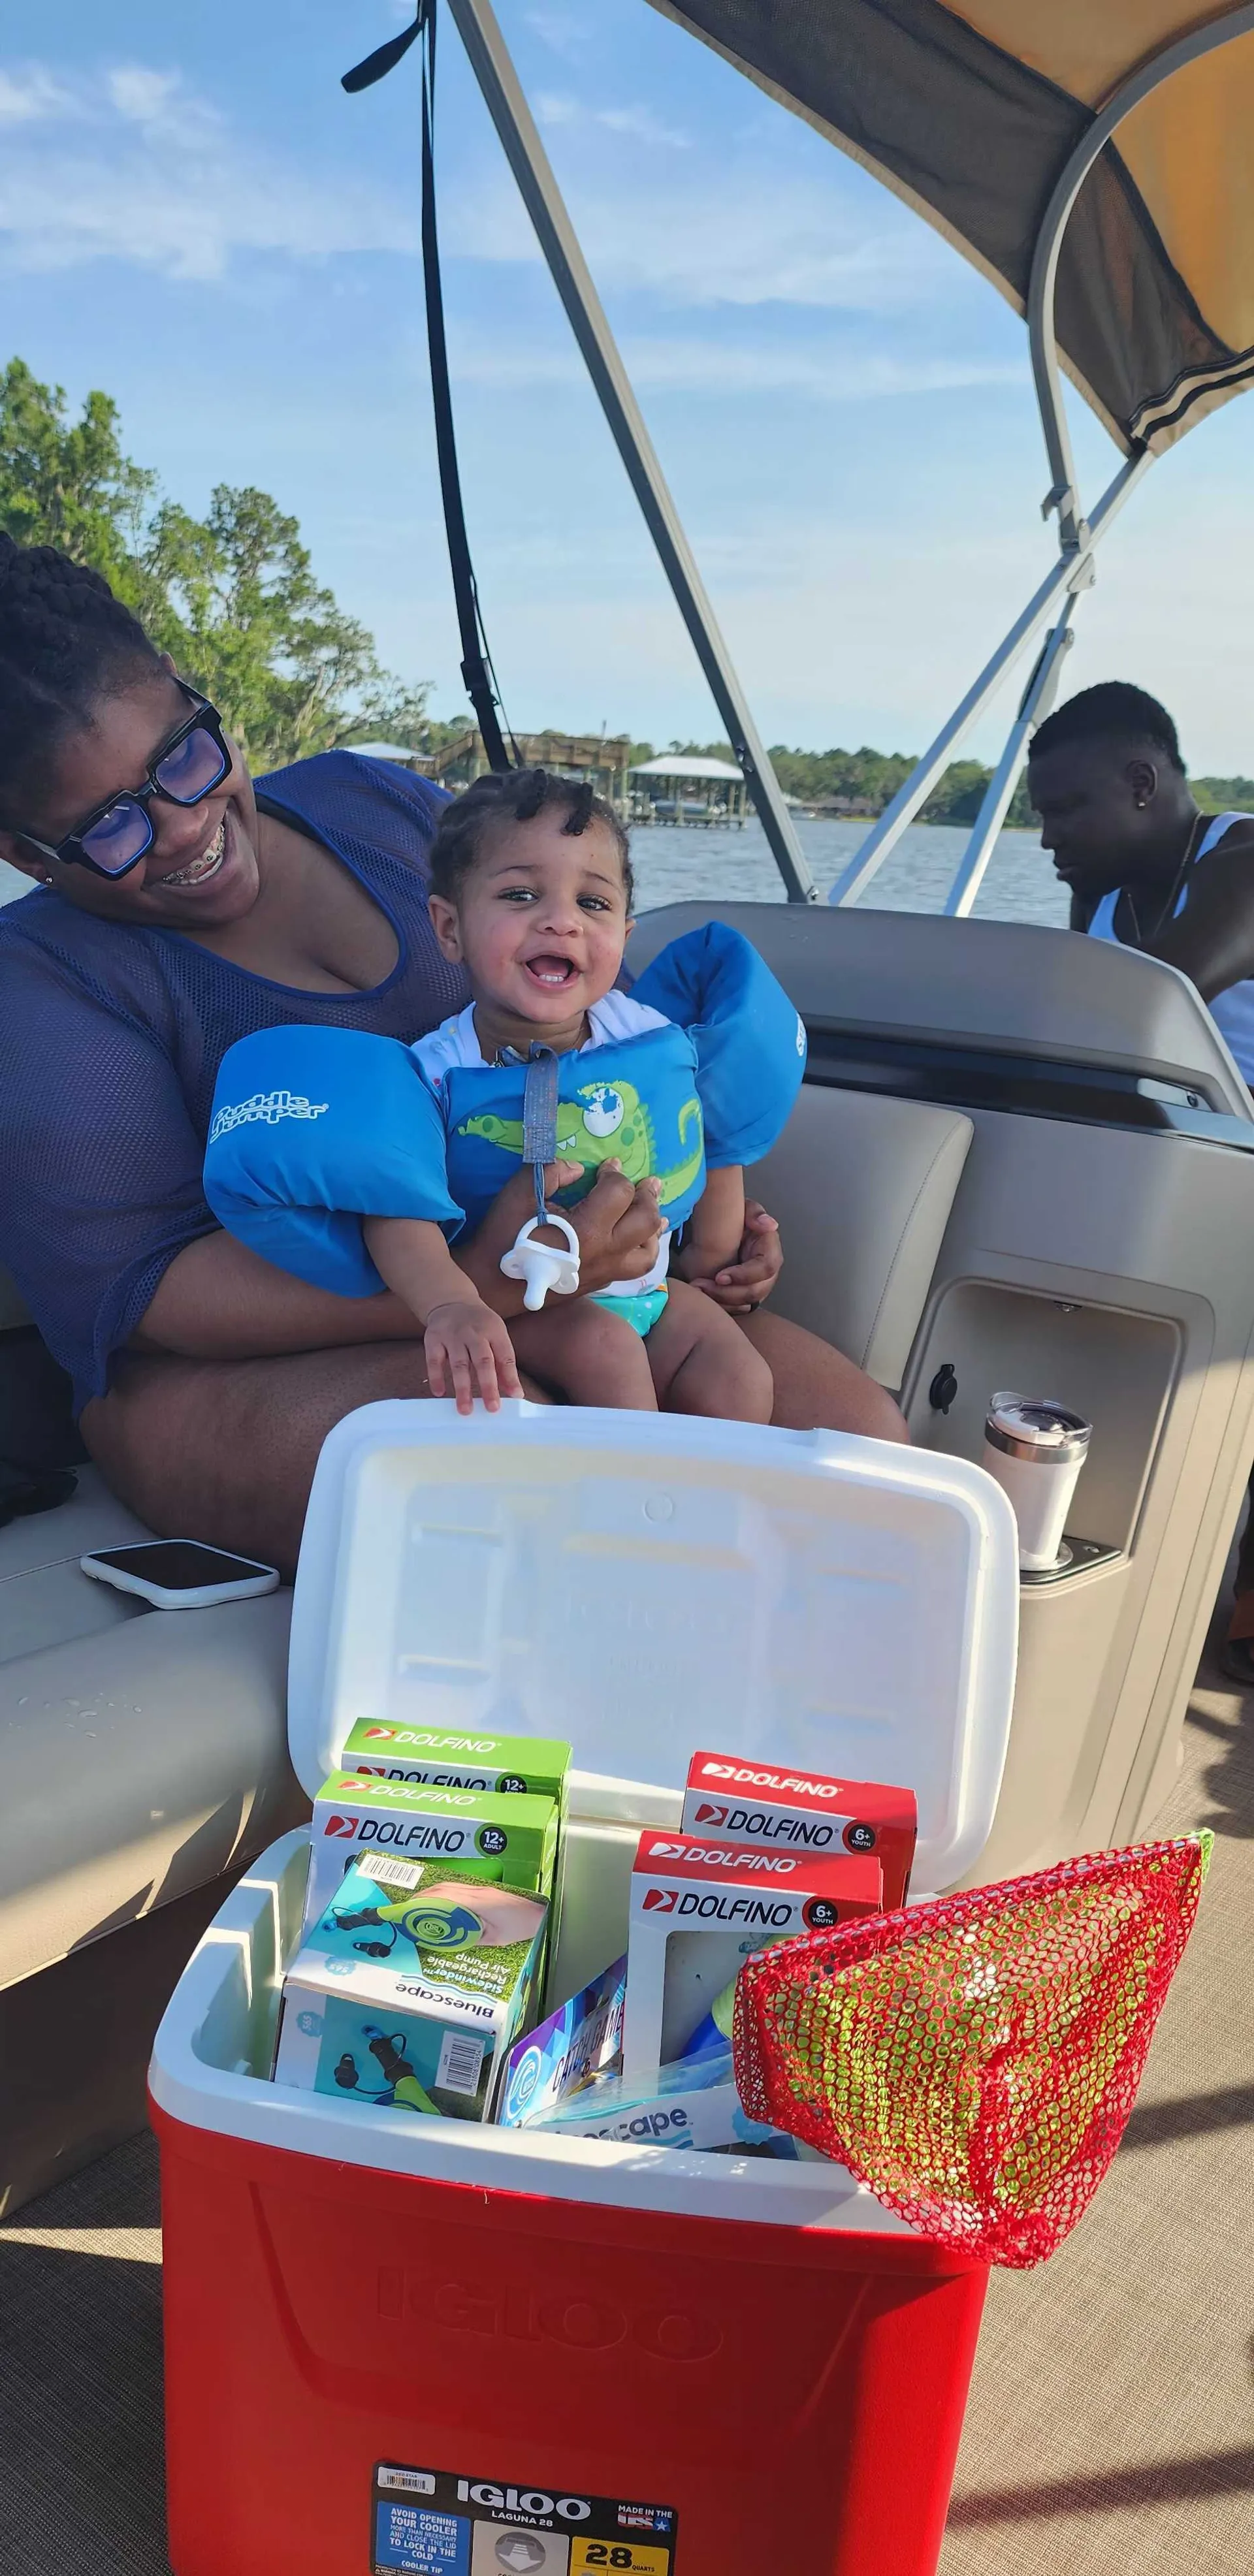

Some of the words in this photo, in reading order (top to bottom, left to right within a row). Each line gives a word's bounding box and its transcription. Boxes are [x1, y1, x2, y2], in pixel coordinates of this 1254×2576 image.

[394, 1731, 496, 1753] DOLFINO
[505, 1779, 524, 1791] 12+
[733, 1768, 839, 1798] DOLFINO
[370, 1785, 478, 1806] DOLFINO
[357, 1819, 466, 1852] DOLFINO
[726, 1809, 834, 1847] DOLFINO
[854, 1828, 871, 1841] 6+
[485, 1831, 504, 1845] 12+
[851, 1838, 871, 1848] YOUTH
[683, 1847, 797, 1873] DOLFINO
[677, 1893, 793, 1927] DOLFINO
[816, 1905, 832, 1918] 6+
[811, 1916, 834, 1925] YOUTH
[426, 1956, 507, 1985] Rechargeable
[455, 1954, 490, 1969] Pump
[491, 1965, 511, 1975] Air
[395, 1983, 495, 2018] Bluescape
[457, 2479, 591, 2520] IGLOO
[391, 2507, 417, 2519] AVOID
[419, 2513, 457, 2528] OPENING
[491, 2510, 537, 2524] LAGUNA
[539, 2519, 554, 2527] 28
[618, 2505, 645, 2515] MADE
[656, 2510, 673, 2519] THE
[390, 2524, 406, 2534] MORE
[408, 2527, 423, 2536] THAN
[425, 2531, 457, 2543] NECESSARY
[391, 2515, 417, 2528] YOUR
[419, 2522, 457, 2536] COOLER
[390, 2531, 405, 2539] AND
[406, 2534, 428, 2545] CLOSE
[430, 2539, 443, 2547] THE
[445, 2541, 457, 2549] LID
[390, 2537, 402, 2547] TO
[404, 2539, 426, 2552] LOCK
[428, 2545, 437, 2554] IN
[440, 2547, 457, 2558] THE
[411, 2550, 434, 2561] COLD
[585, 2544, 633, 2568] 28
[401, 2560, 428, 2571] COOLER
[430, 2566, 443, 2575] TIP
[632, 2564, 655, 2573] QUARTS
